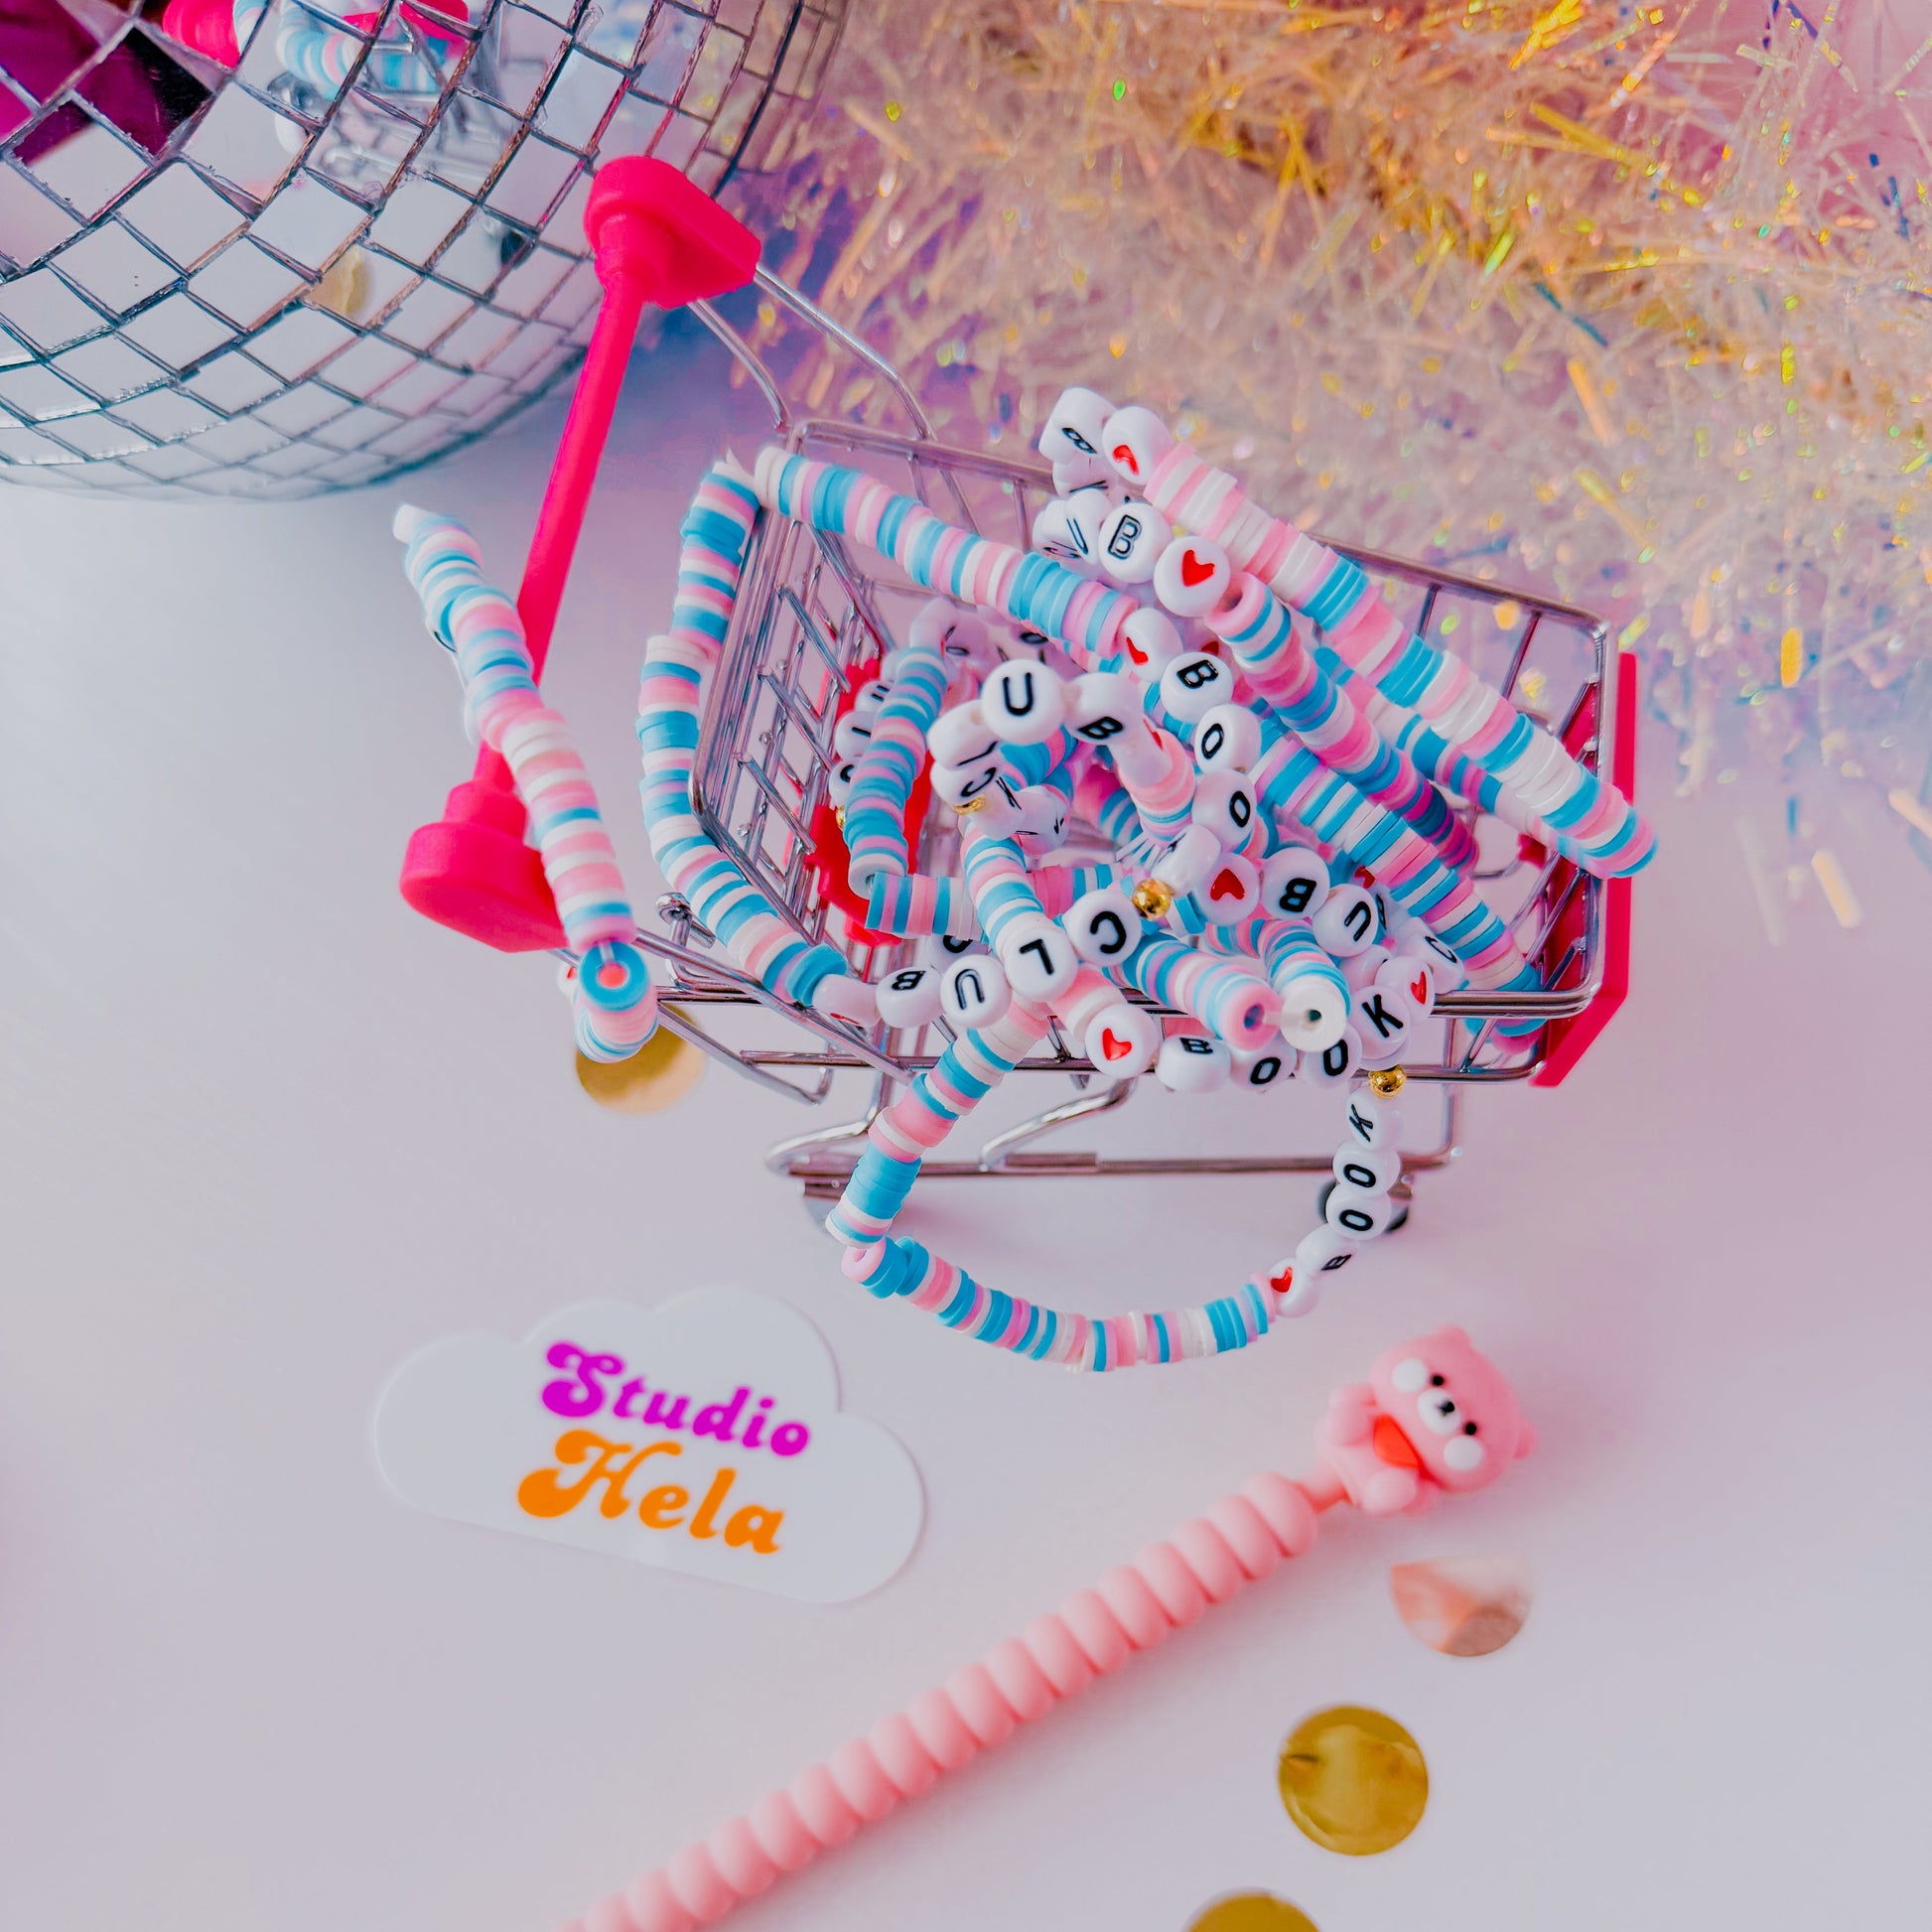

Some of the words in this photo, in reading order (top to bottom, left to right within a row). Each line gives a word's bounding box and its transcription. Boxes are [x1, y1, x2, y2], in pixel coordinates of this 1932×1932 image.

[892, 910, 1127, 1010] CLUB
[1179, 994, 1404, 1085] BOOK
[1320, 1103, 1377, 1272] BOOK
[542, 1341, 810, 1457] Studio
[517, 1429, 784, 1555] Hela
